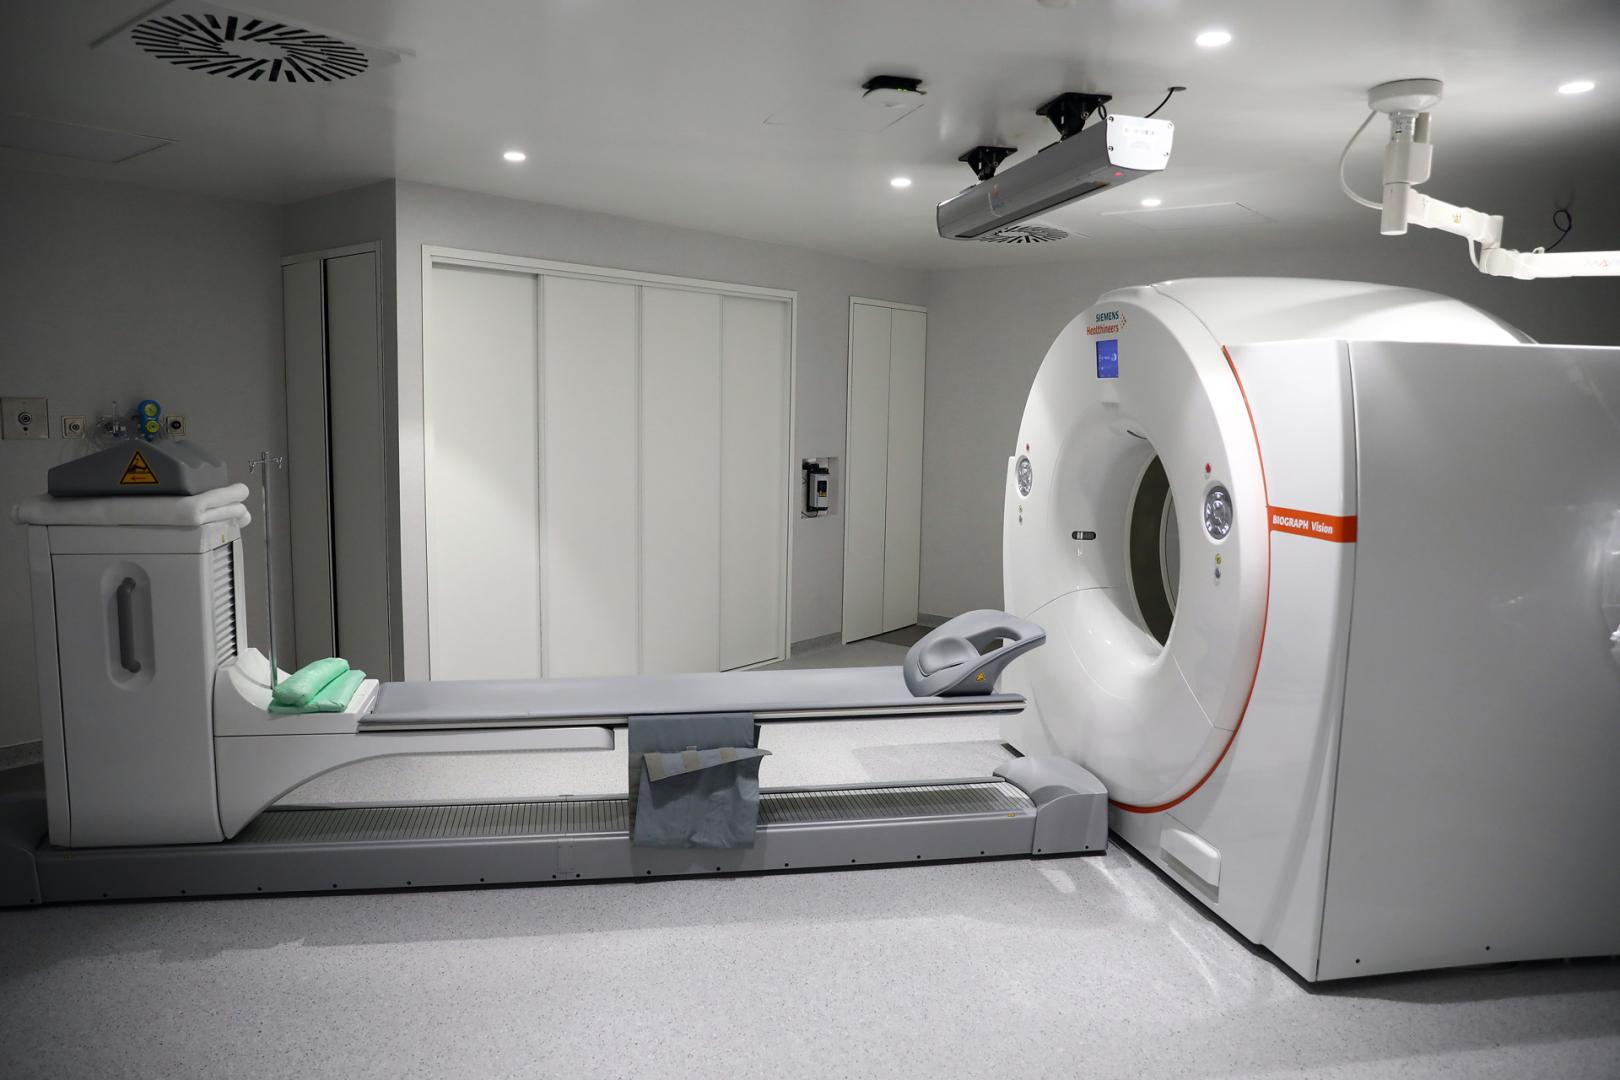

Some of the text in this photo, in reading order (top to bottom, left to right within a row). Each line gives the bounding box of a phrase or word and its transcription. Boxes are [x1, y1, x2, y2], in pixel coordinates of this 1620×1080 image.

[1096, 310, 1119, 322] SIEMENS
[1087, 324, 1119, 335] Healthineers
[1272, 514, 1334, 534] BIOGRAPH Vision
